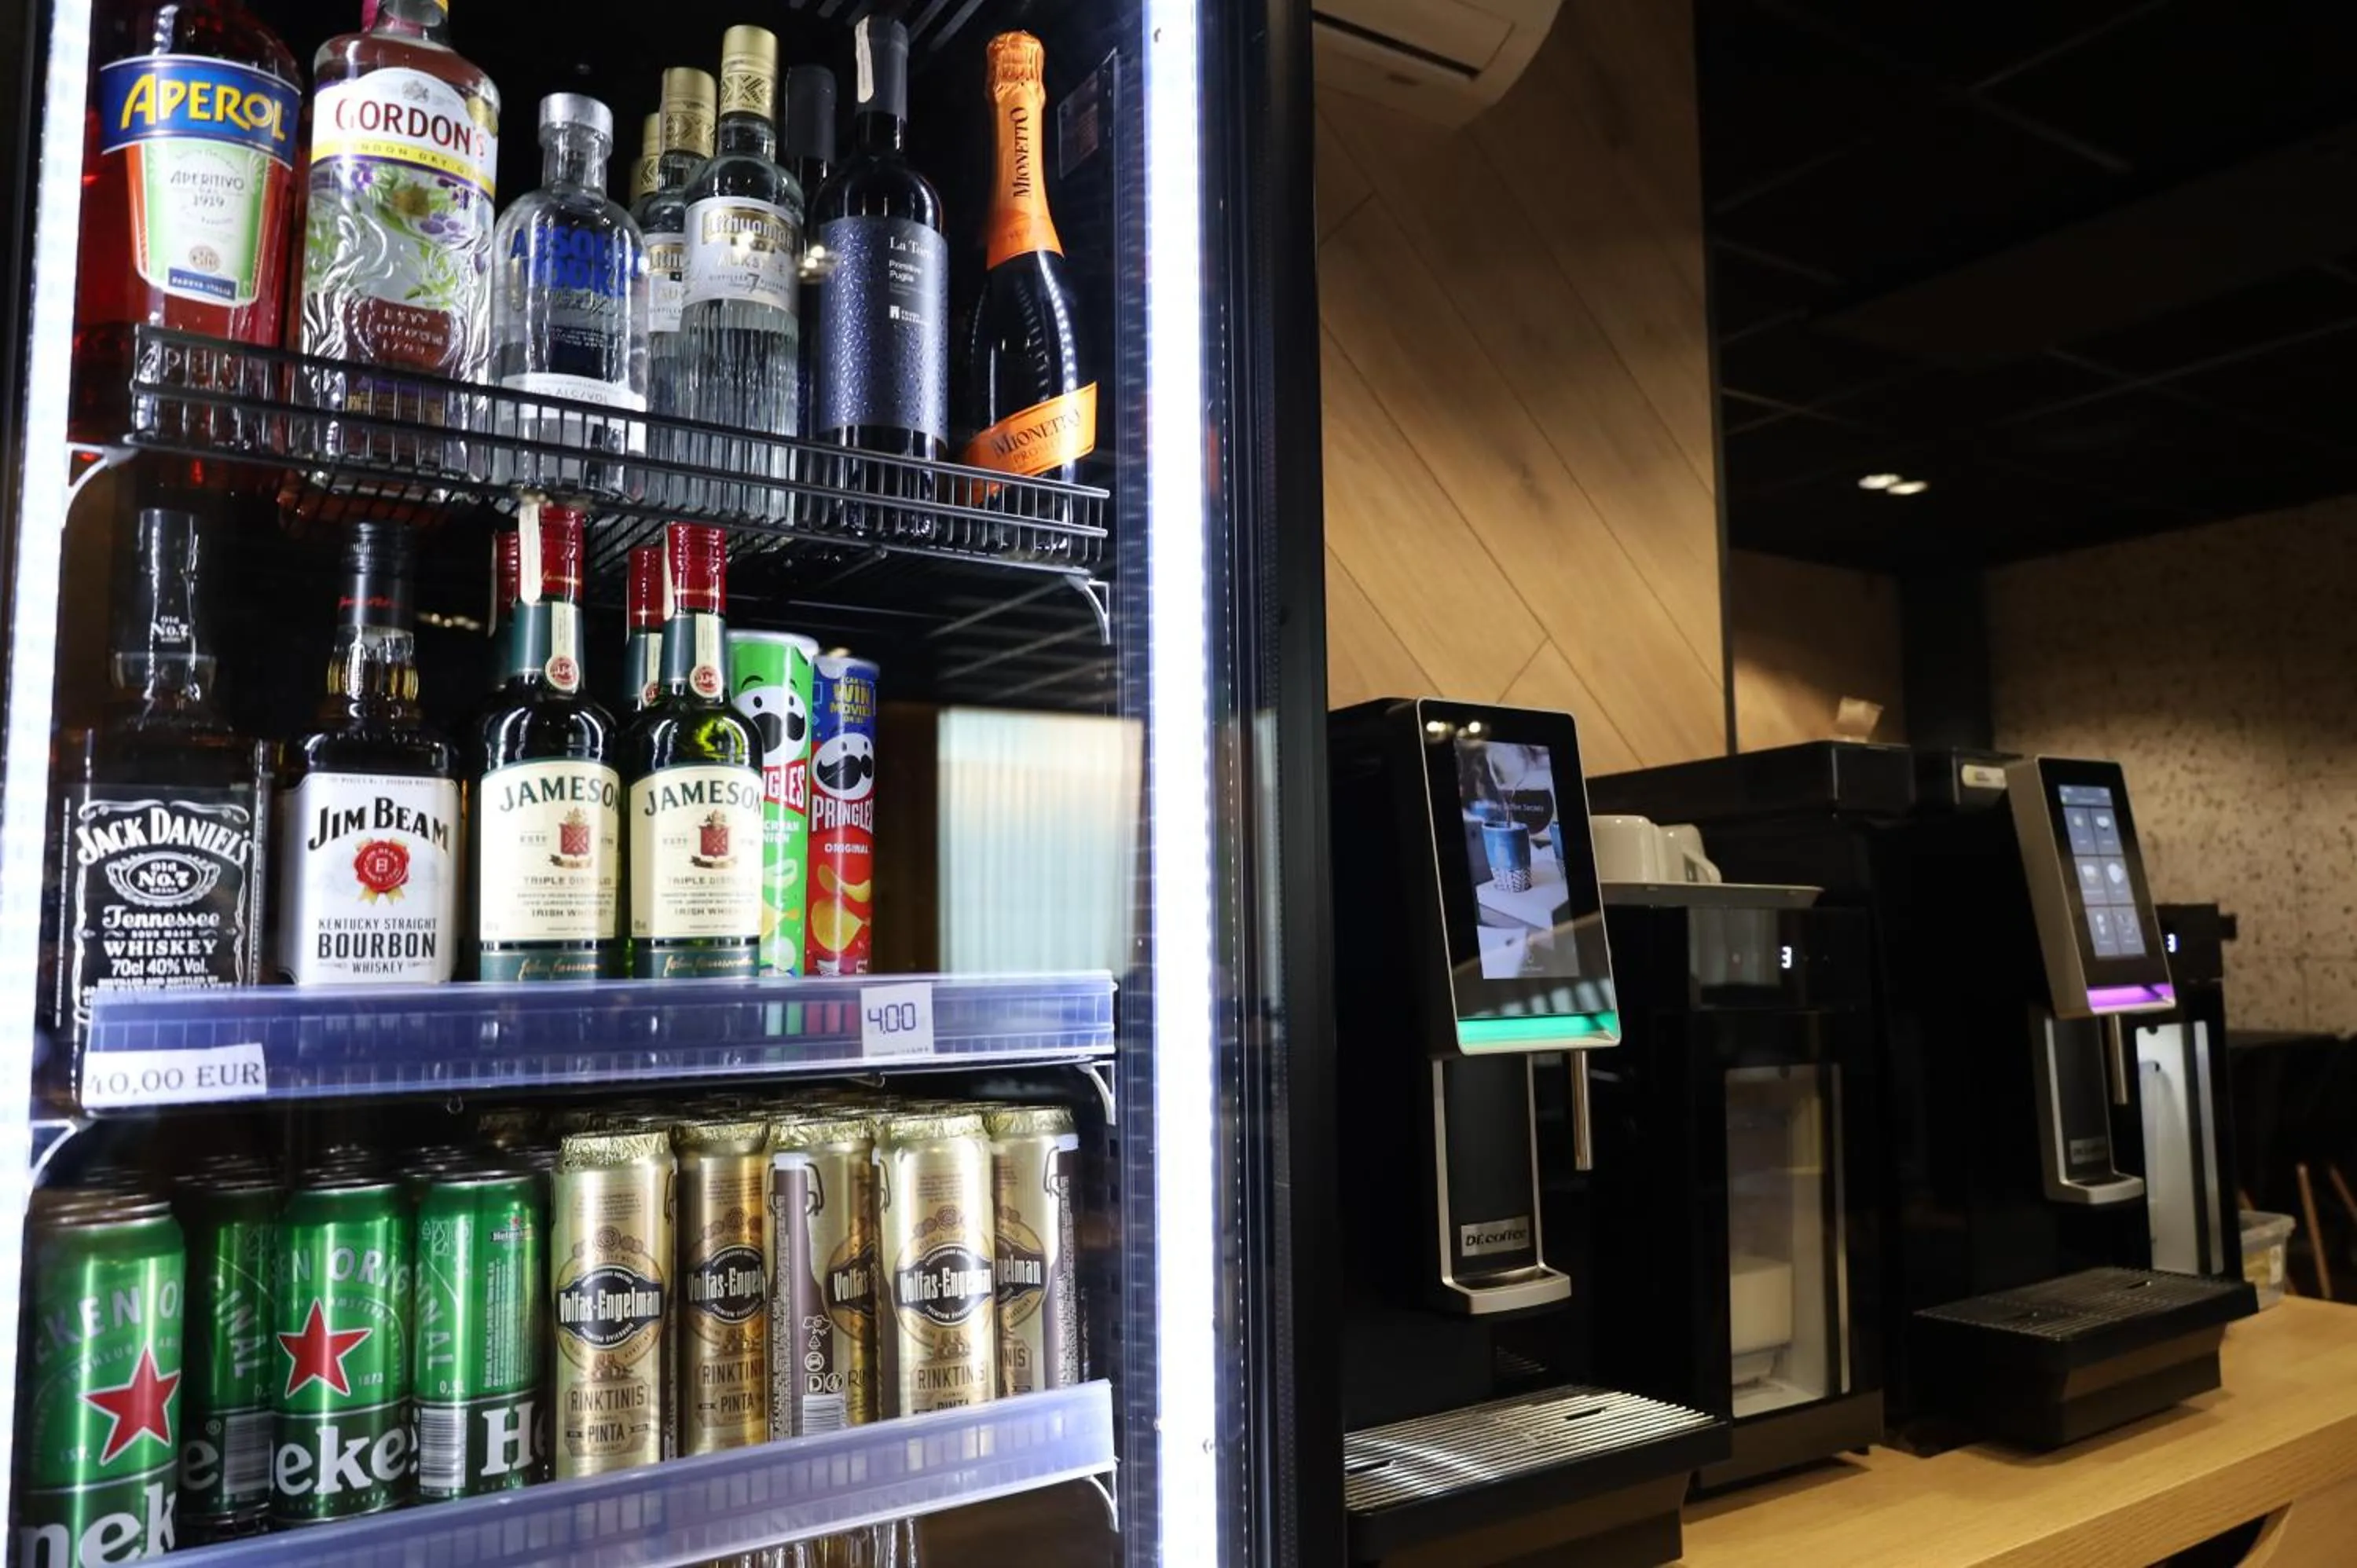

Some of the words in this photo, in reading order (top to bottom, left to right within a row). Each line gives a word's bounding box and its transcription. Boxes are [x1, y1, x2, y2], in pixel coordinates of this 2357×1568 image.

[119, 73, 286, 143] APEROL
[1010, 106, 1031, 199] MIONETTO
[170, 170, 244, 191] APERITIVO
[75, 817, 148, 865] JACK
[150, 807, 254, 865] DANIEL'S
[307, 806, 368, 851] JIM
[372, 797, 450, 854] BEAM
[150, 862, 178, 871] Old
[137, 870, 190, 888] No.7
[101, 904, 220, 929] Tennessee
[317, 918, 379, 931] KENTUCKY
[383, 918, 438, 931] STRAIGHT
[102, 939, 219, 958] WHISKEY
[317, 932, 437, 959] BOURBON
[1780, 946, 1793, 969] 3
[110, 958, 144, 976] 70cl
[146, 958, 181, 976] 40%
[182, 958, 210, 975] Vol.
[353, 961, 403, 974] WHISKEY
[867, 1002, 917, 1035] 4.00
[196, 1061, 261, 1087] EUR
[597, 1286, 660, 1322] Engelman
[570, 1385, 644, 1412] RINKTINIS
[720, 1391, 754, 1413] PINTA
[587, 1423, 626, 1444] PINTA
